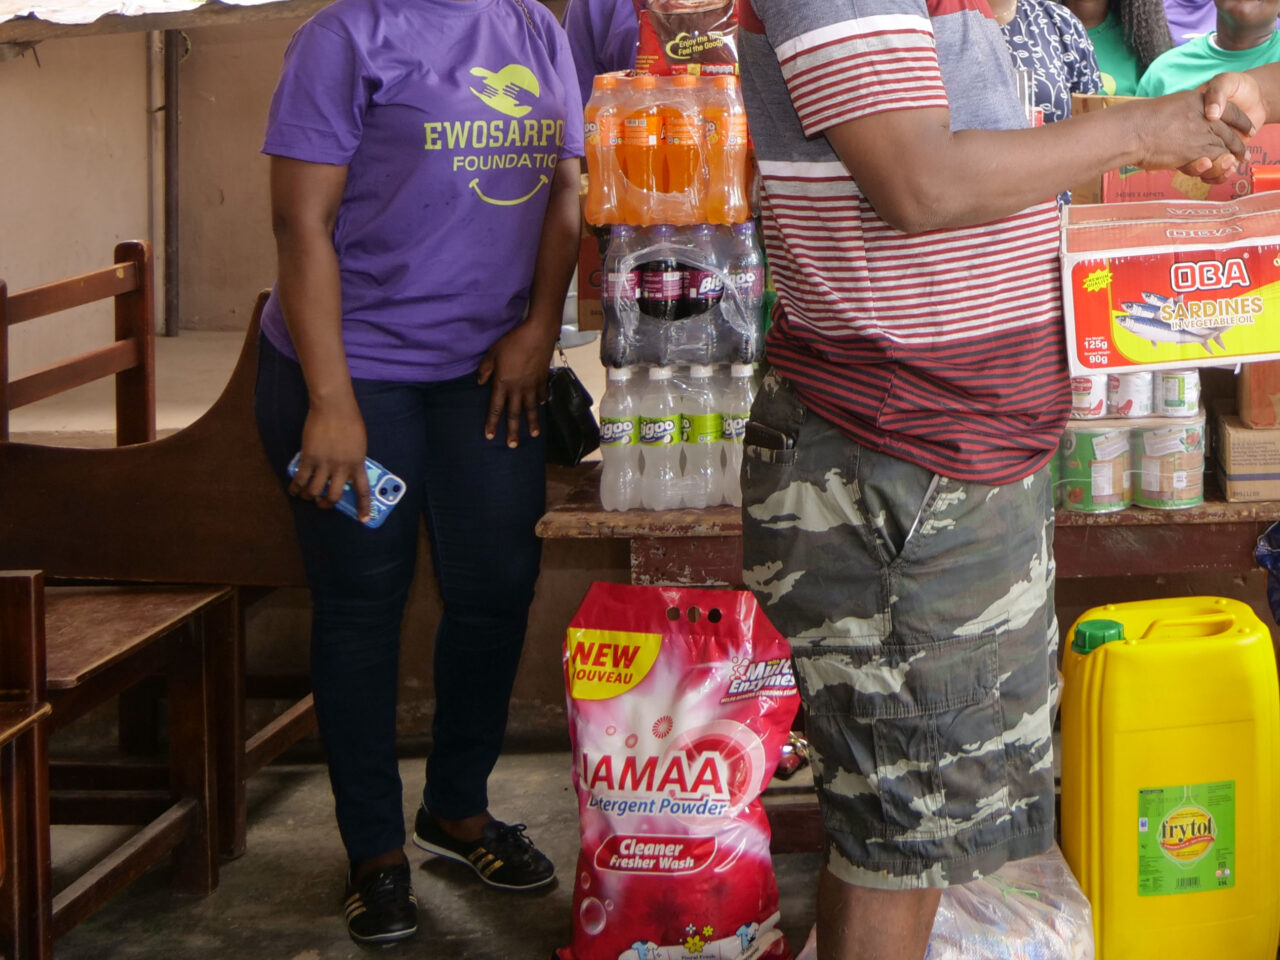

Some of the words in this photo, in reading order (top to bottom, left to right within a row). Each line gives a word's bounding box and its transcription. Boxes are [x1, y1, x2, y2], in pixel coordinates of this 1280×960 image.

[1171, 258, 1250, 292] OBA
[1160, 296, 1263, 321] SARDINES
[1172, 322, 1182, 331] IN
[1184, 317, 1236, 329] VEGETABLE
[1238, 315, 1254, 324] OIL
[1084, 340, 1108, 349] 125g
[1089, 355, 1108, 364] 90g
[602, 420, 633, 438] igoo
[642, 420, 673, 439] igoo
[572, 641, 640, 669] NEW
[574, 669, 633, 685] OUVEAU
[728, 674, 796, 694] Enzymes
[590, 796, 655, 816] Dtergent
[659, 798, 727, 815] Powder
[1162, 817, 1212, 843] frytol
[620, 839, 683, 856] Cleaner
[610, 856, 656, 869] Fresher
[659, 857, 694, 870] Wash
